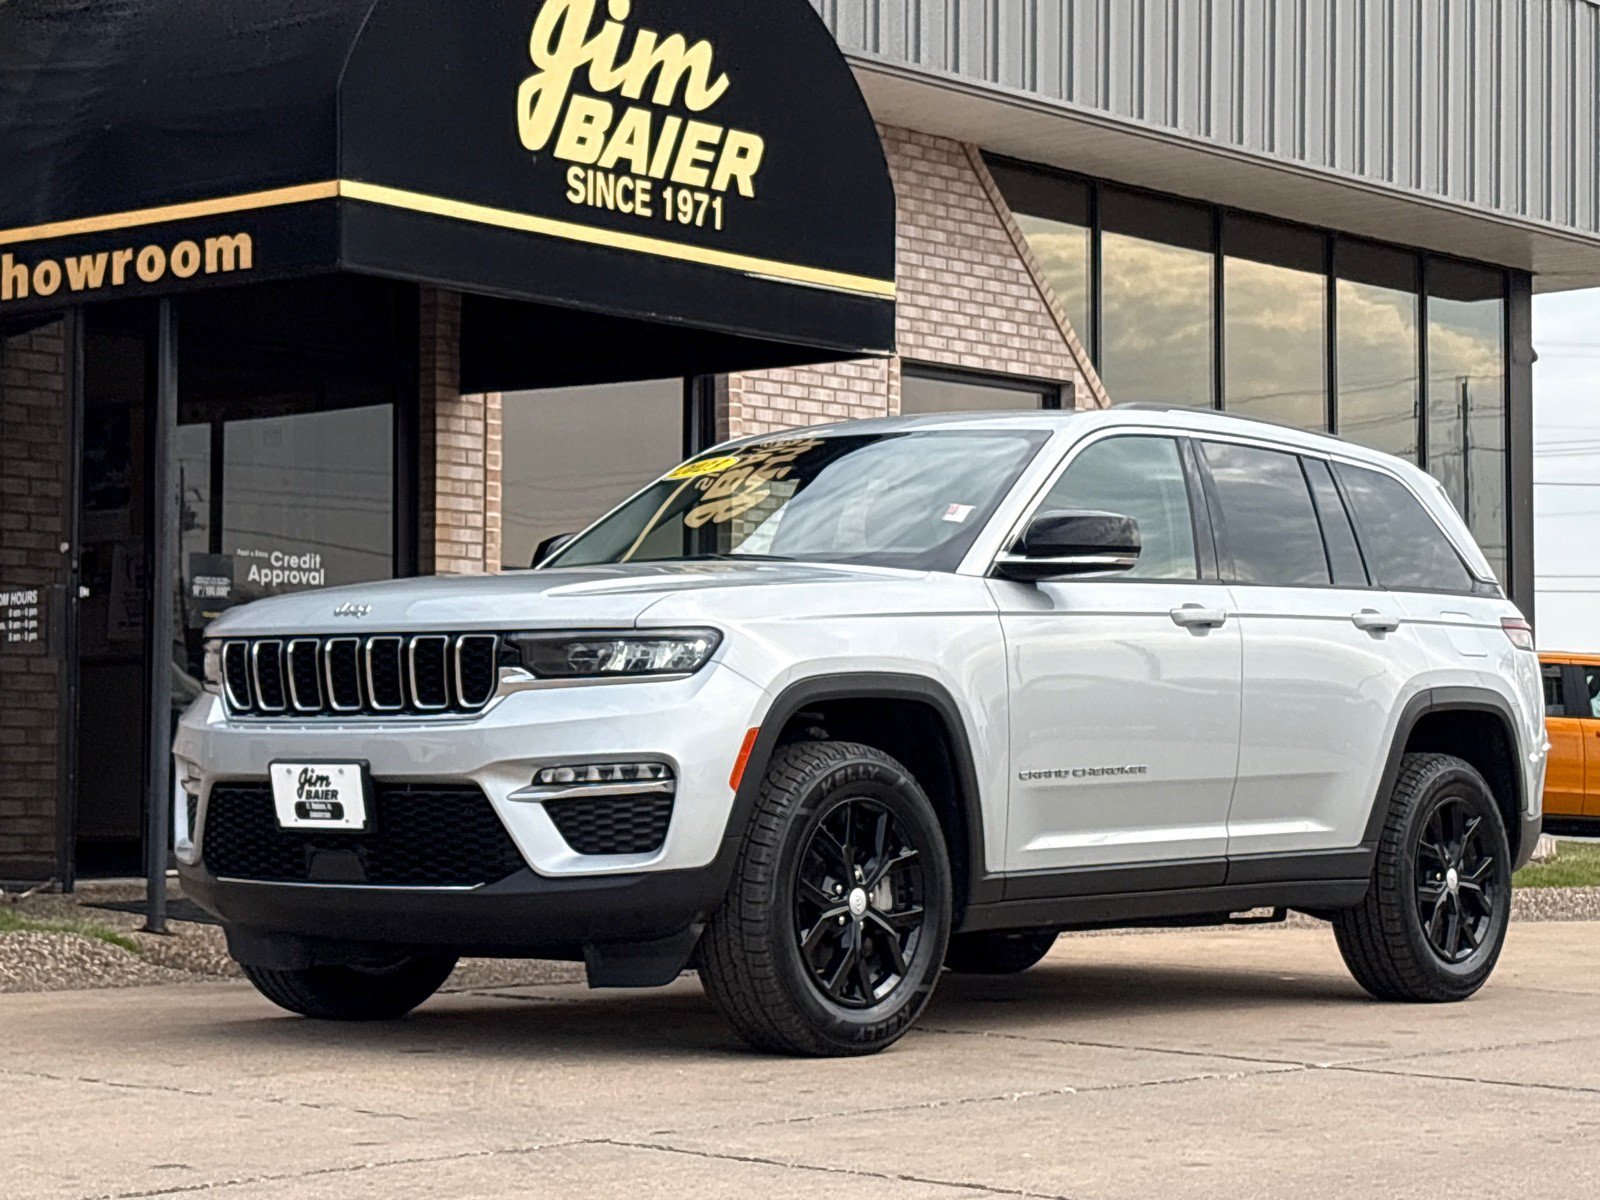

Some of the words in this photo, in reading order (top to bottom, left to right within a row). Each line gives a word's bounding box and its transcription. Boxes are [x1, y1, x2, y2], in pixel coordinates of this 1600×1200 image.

[517, 0, 730, 150] Jim
[553, 94, 764, 198] BAIER
[566, 166, 652, 217] SINCE
[662, 187, 722, 231] 1971
[1, 232, 252, 300] howroom
[247, 563, 325, 588] Approval
[270, 550, 321, 570] Credit
[10, 589, 38, 606] HOURS
[297, 767, 331, 799] Jim
[305, 789, 339, 800] BAIER
